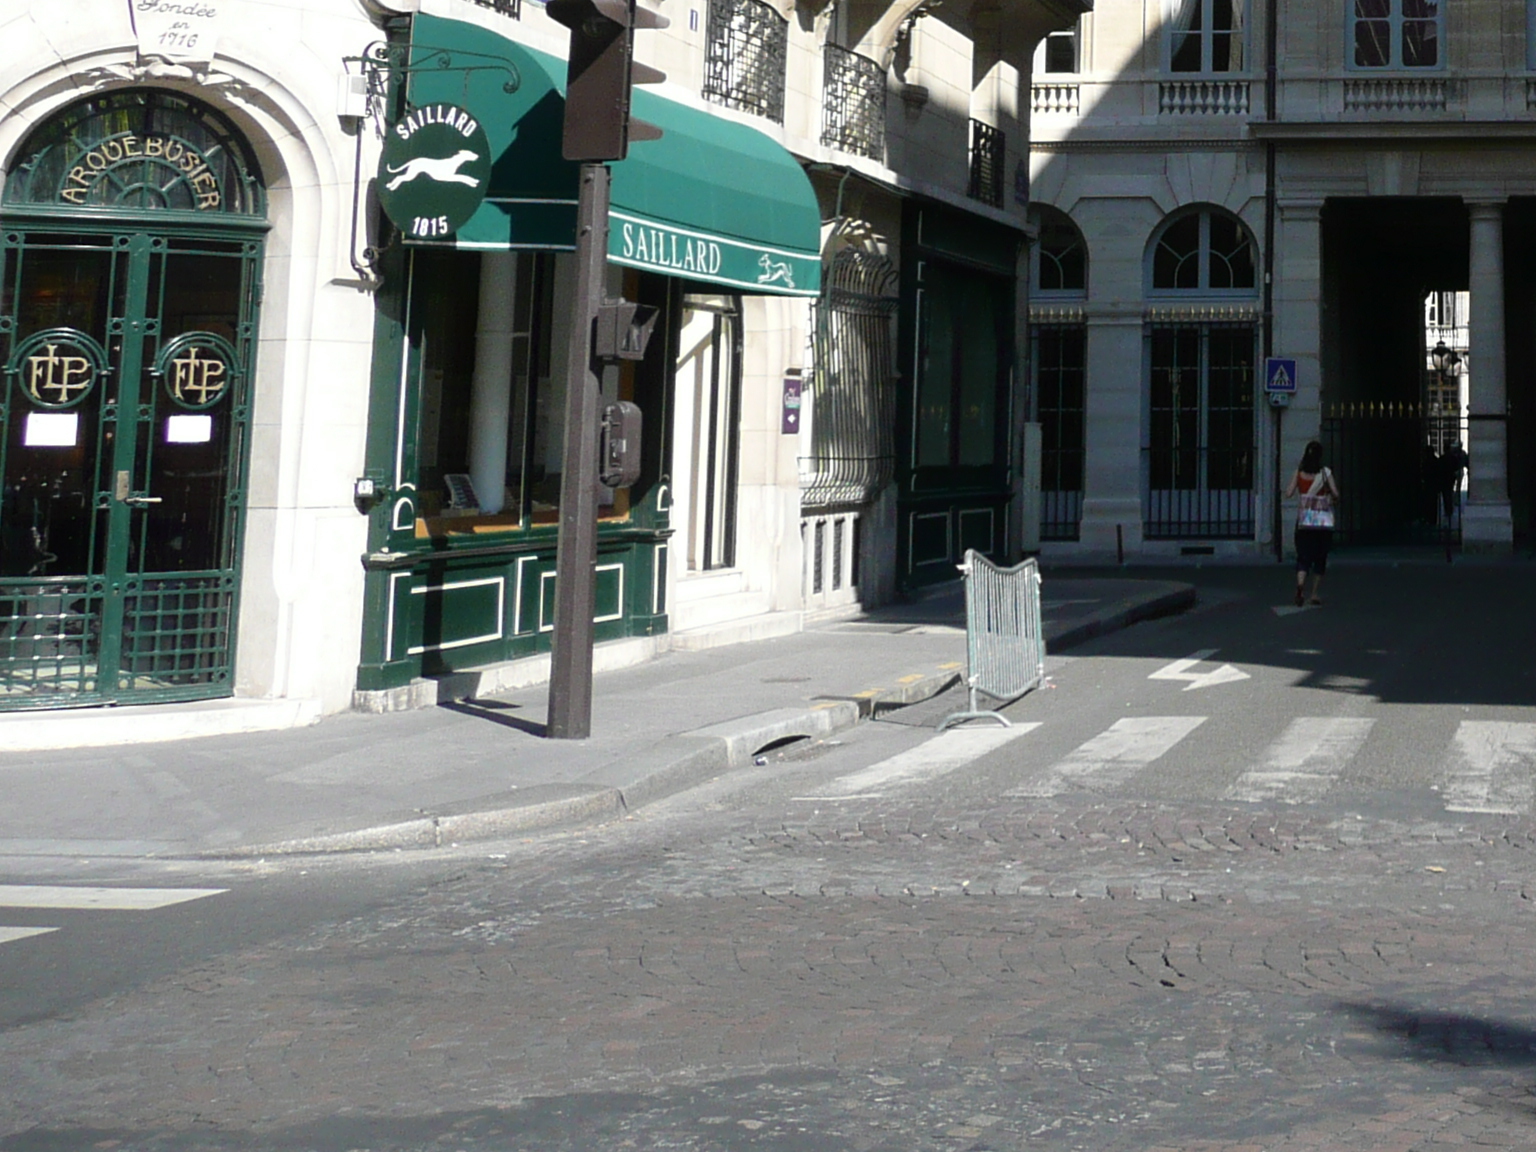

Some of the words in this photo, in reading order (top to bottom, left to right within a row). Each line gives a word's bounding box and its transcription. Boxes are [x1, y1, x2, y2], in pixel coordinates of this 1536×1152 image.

[158, 31, 199, 49] 1716
[396, 105, 479, 142] SAILLARD
[61, 135, 221, 211] ARQUEBUSIER
[411, 215, 449, 238] 1815
[622, 222, 721, 276] SAILLARD
